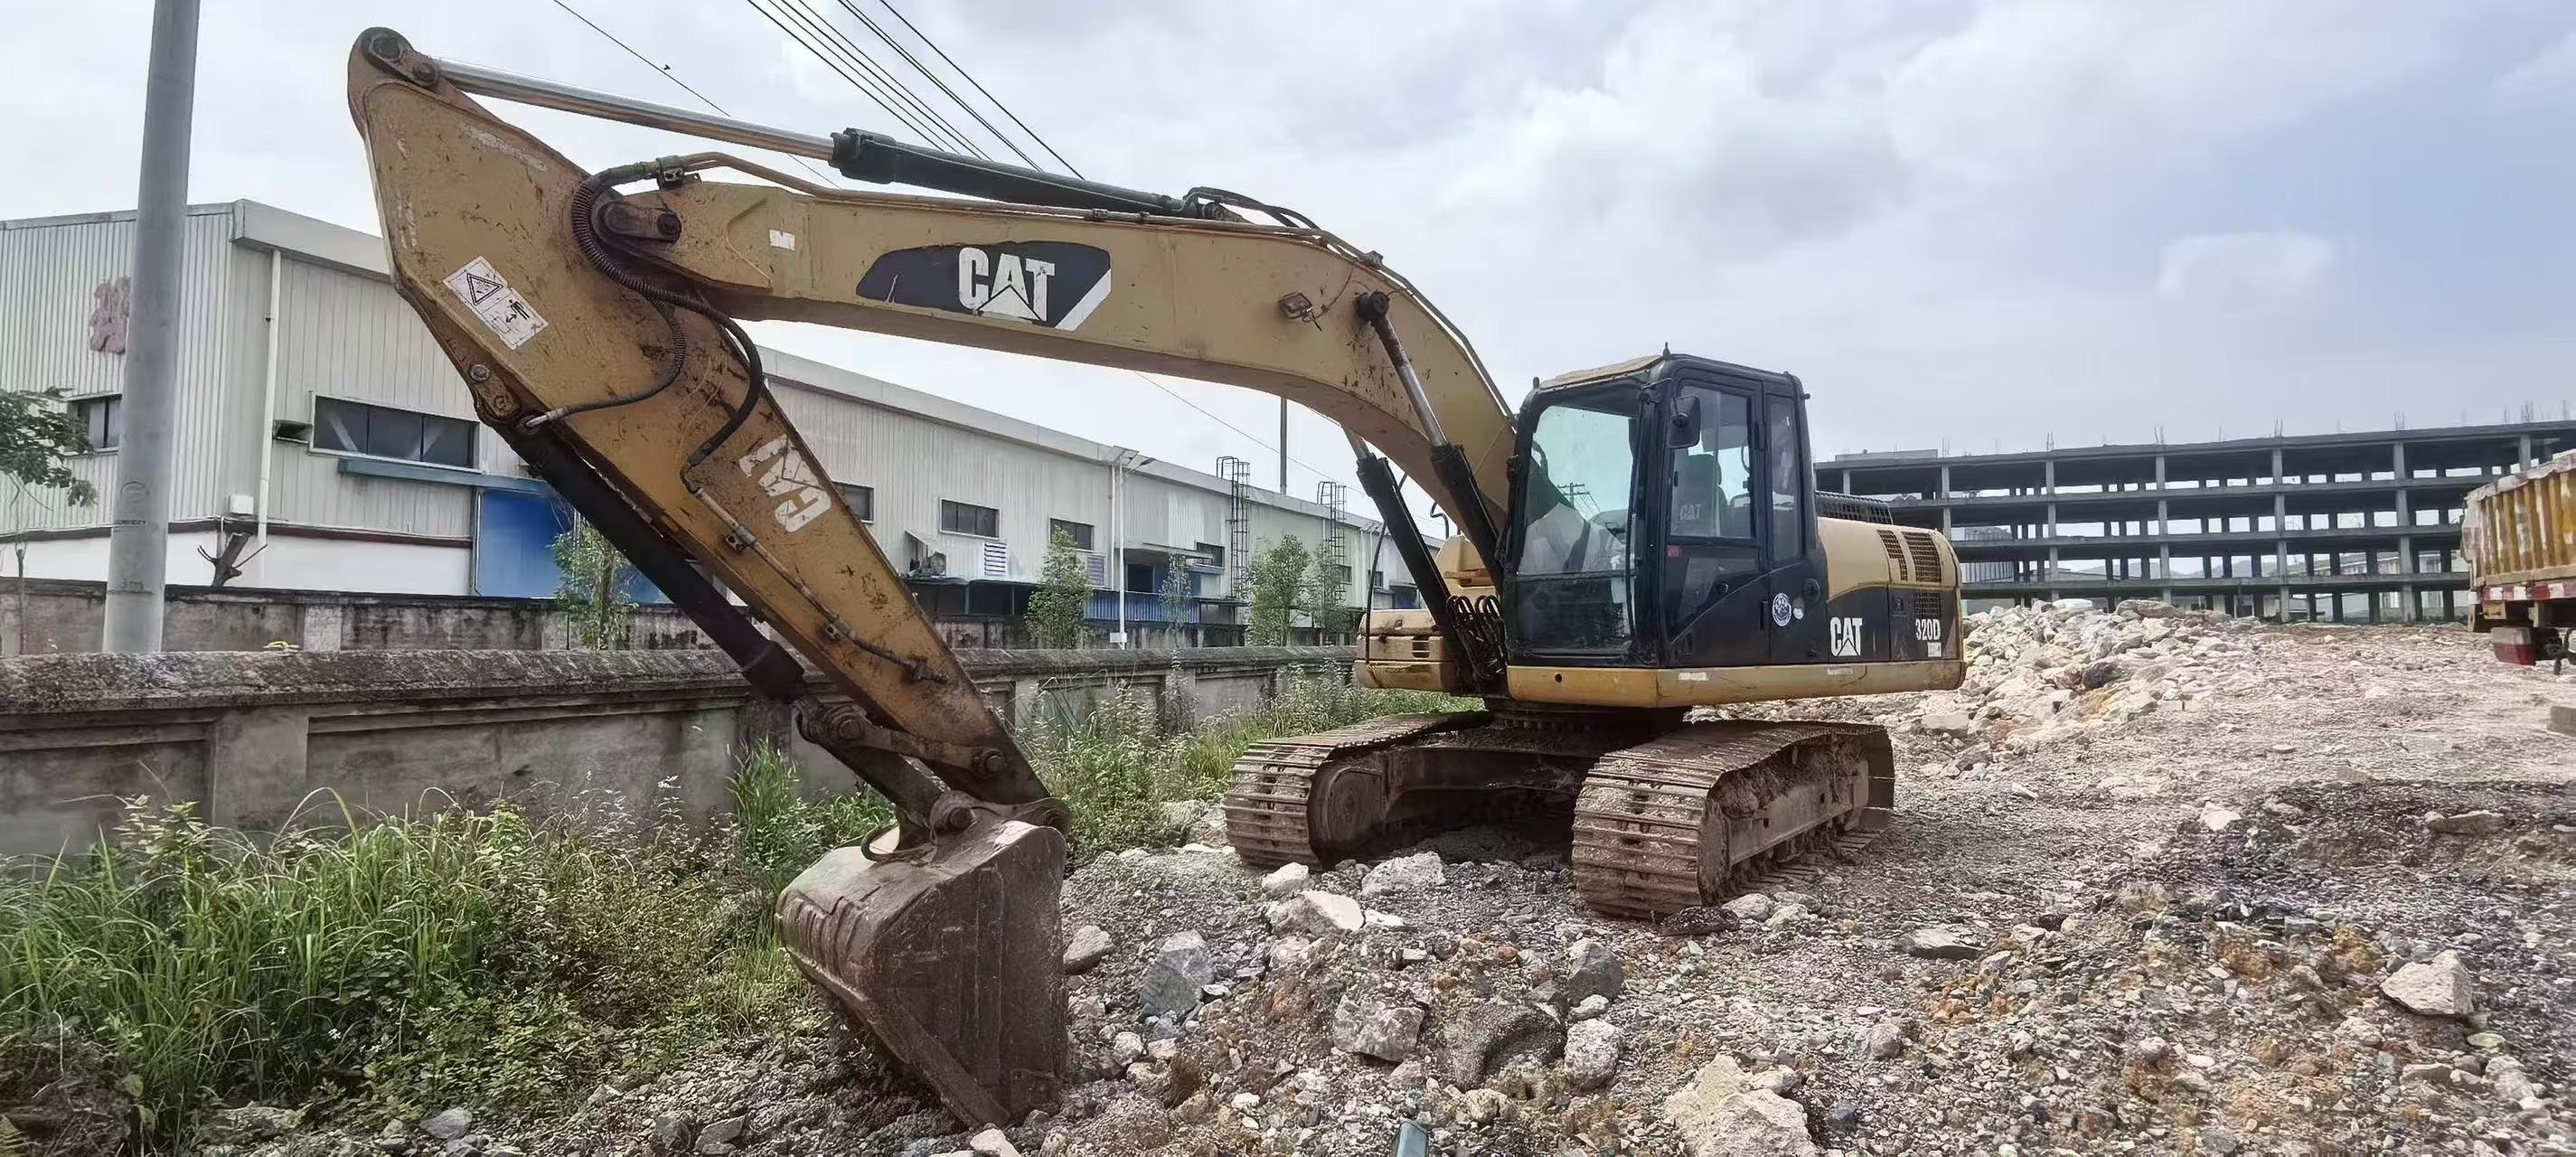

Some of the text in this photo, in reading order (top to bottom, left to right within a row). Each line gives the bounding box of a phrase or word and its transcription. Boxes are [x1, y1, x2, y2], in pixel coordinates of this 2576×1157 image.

[958, 247, 1056, 322] CAT
[738, 433, 832, 532] CAT
[1679, 503, 1702, 522] CAT
[1829, 616, 1863, 657] CAT
[1915, 618, 1941, 641] 320D
